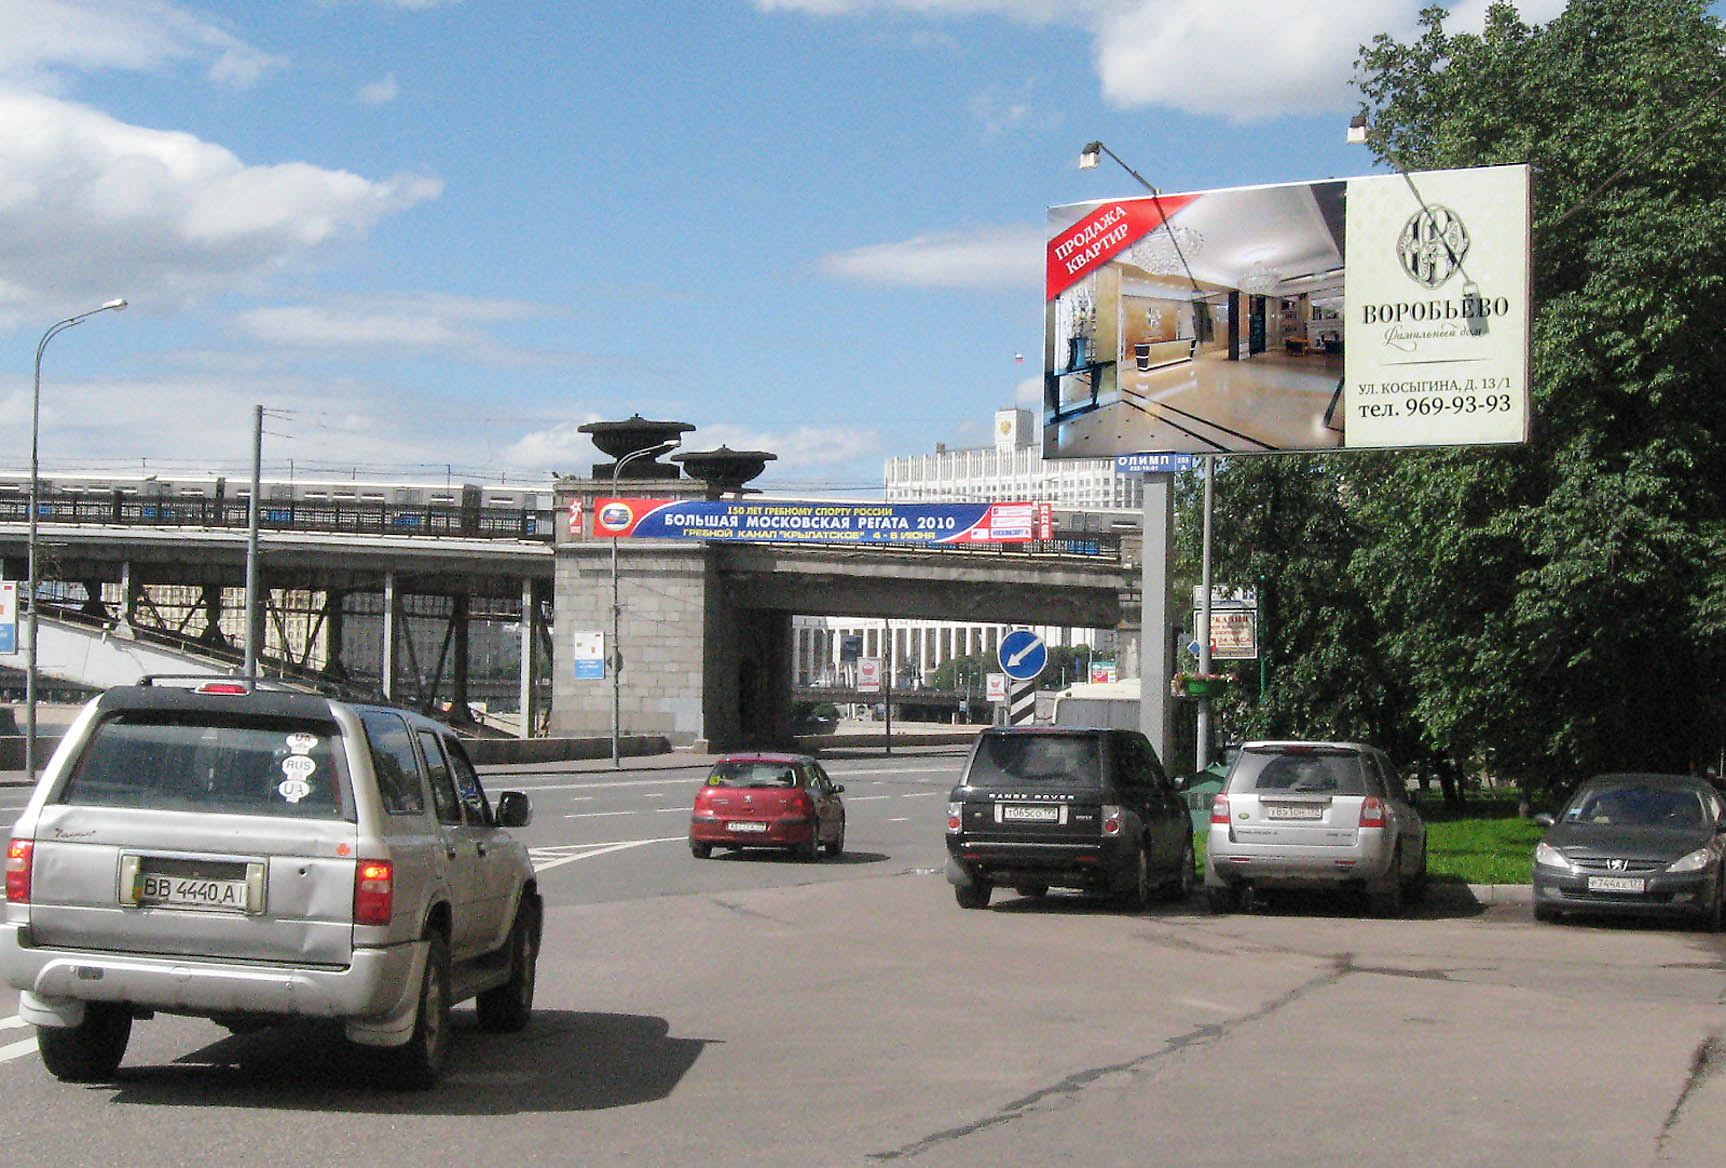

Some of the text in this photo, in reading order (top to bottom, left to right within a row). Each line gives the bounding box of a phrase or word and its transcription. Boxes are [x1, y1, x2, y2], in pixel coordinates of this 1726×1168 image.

[1055, 206, 1127, 261] ПРОДАЖА
[1065, 223, 1129, 275] КВАРТИР
[1358, 384, 1379, 396] УЛ.
[1381, 379, 1462, 394] КОСЫГИНА,
[1483, 377, 1512, 390] 13/1
[1358, 394, 1512, 418] тел. 969-93-93
[1118, 455, 1169, 466] ОЛИМП
[727, 506, 893, 516] 150 ЛЕТ ГРЕБНОМУ СПОРТУ РОССИИ
[664, 513, 956, 529] БОЛЬШАЯ МОСКОВСКАЯ РЕГАТА 2010
[683, 528, 733, 537] ГРЕБНОЙ
[738, 530, 777, 539] КАНАЛ
[901, 532, 937, 540] ИЮНЯ
[286, 759, 311, 771] RUS
[284, 782, 304, 796] UA
[177, 881, 218, 901] 4440
